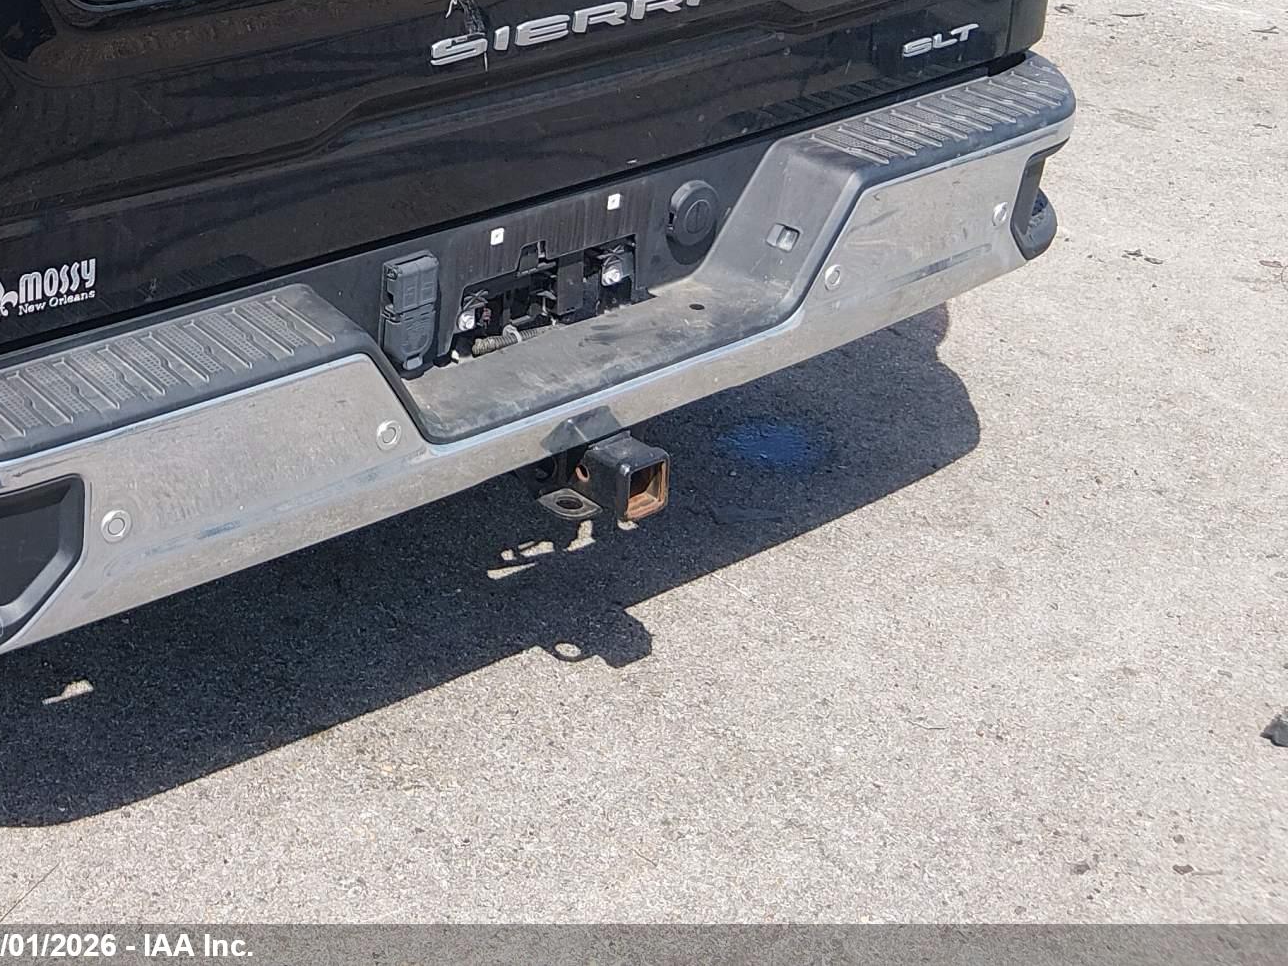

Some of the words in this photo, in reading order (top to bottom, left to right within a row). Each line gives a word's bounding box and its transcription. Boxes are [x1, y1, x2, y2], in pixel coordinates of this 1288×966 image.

[902, 23, 979, 58] SLT
[18, 300, 47, 316] New
[49, 289, 96, 308] Orleans
